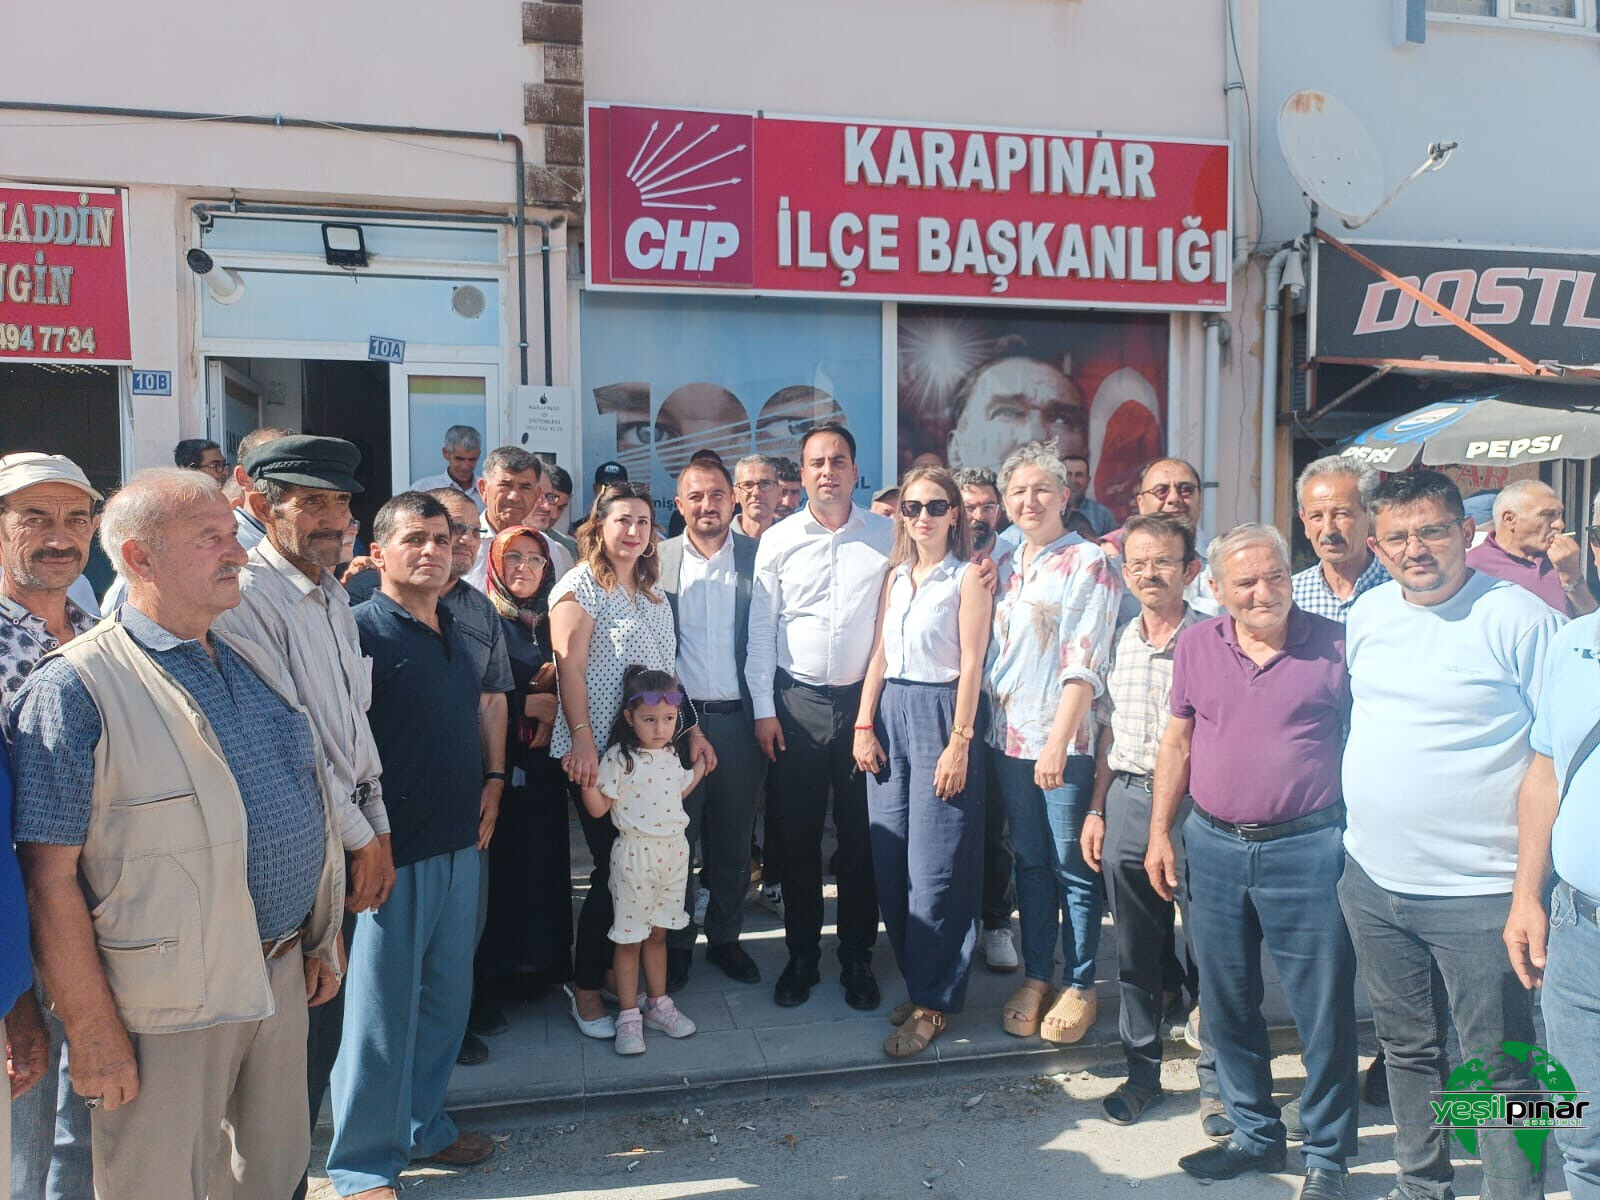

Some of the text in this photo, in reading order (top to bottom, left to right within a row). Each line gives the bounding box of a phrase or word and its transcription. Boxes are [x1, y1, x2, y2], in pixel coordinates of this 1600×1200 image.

[844, 125, 1156, 199] KARAPINAR
[624, 215, 740, 273] CHP
[778, 195, 1227, 293] İLÇE BAŞKANLIĞI
[0, 249, 74, 307] GİN
[38, 325, 97, 355] 7734
[1465, 434, 1564, 460] PEPSI
